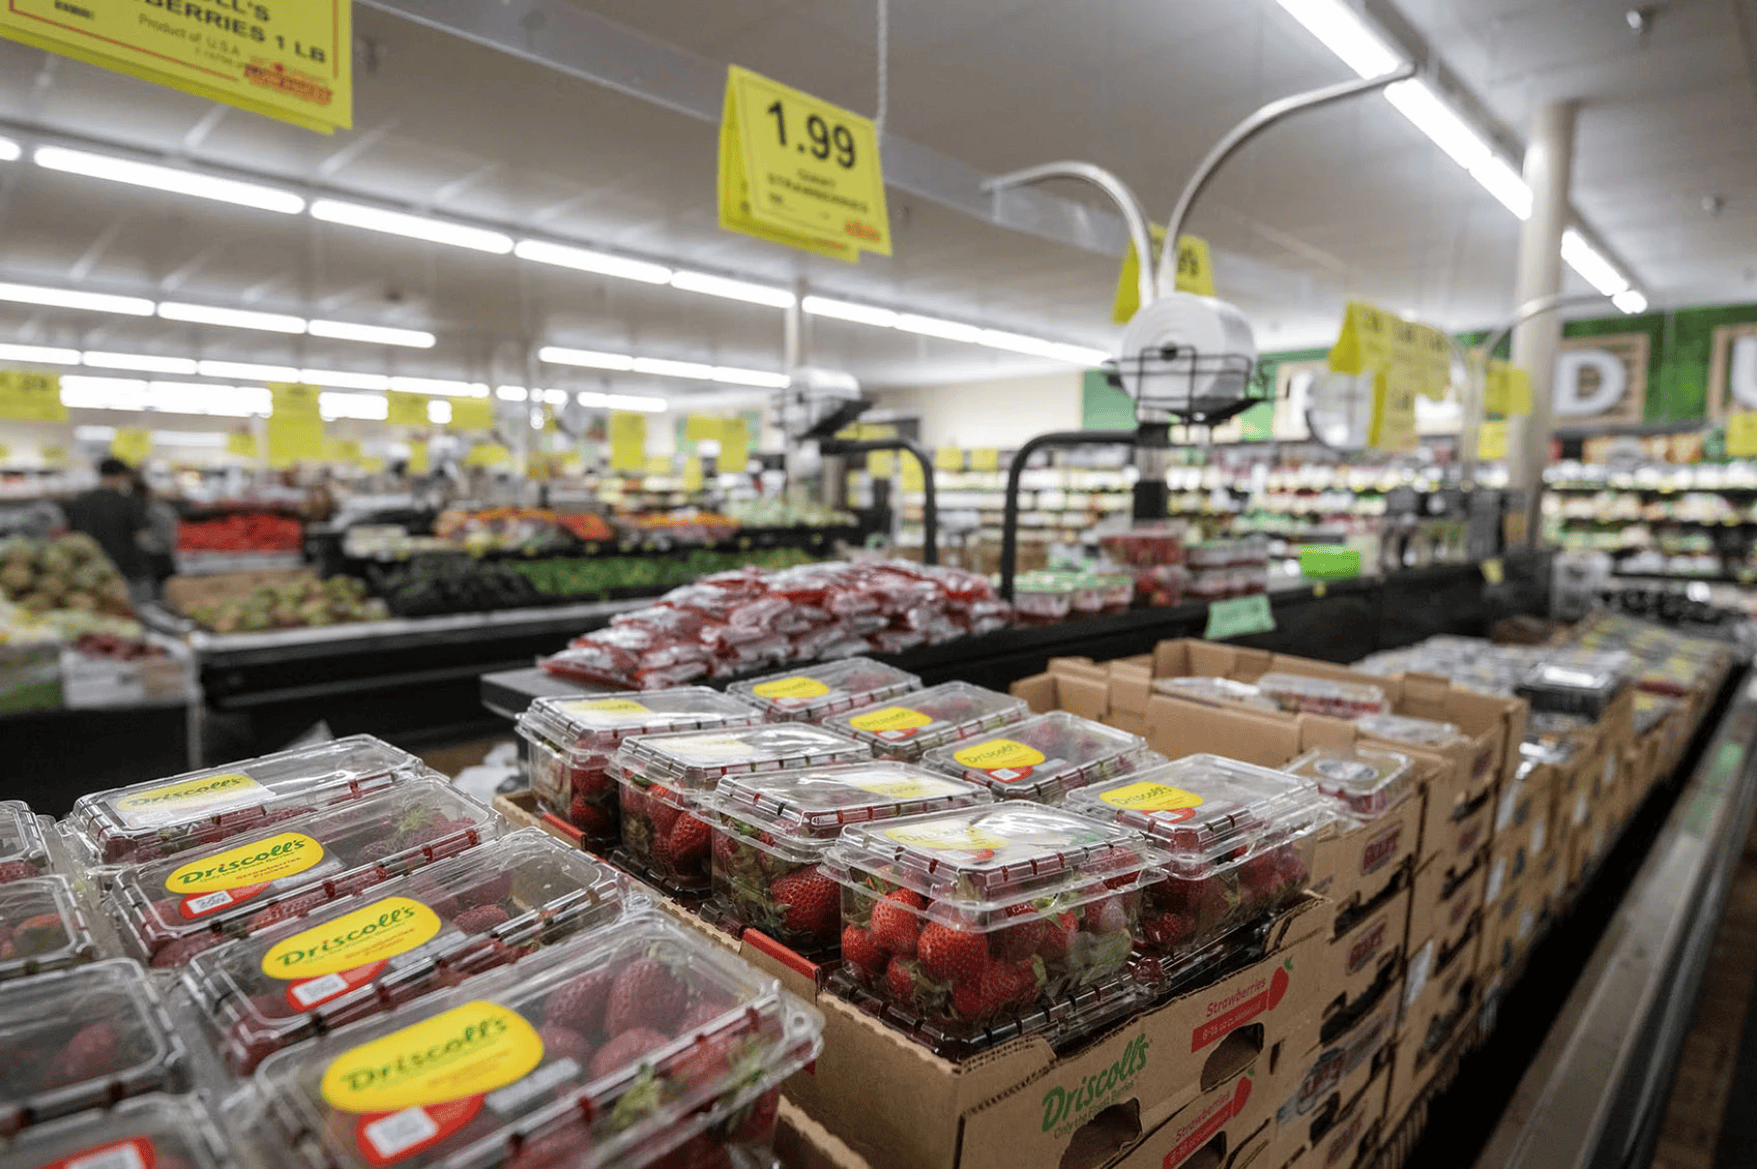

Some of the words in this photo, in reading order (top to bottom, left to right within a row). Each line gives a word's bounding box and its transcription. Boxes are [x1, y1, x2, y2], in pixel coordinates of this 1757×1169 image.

[275, 34, 286, 51] 1
[293, 40, 327, 64] LB
[766, 100, 858, 170] 1.99
[127, 776, 243, 808] Driscoll's
[177, 838, 307, 885] Driscoll's
[274, 905, 416, 968] Driscoll's
[1206, 977, 1267, 1018] Strawberries
[341, 1014, 508, 1092] Driscoll's
[1041, 1032, 1150, 1132] Driscoll's
